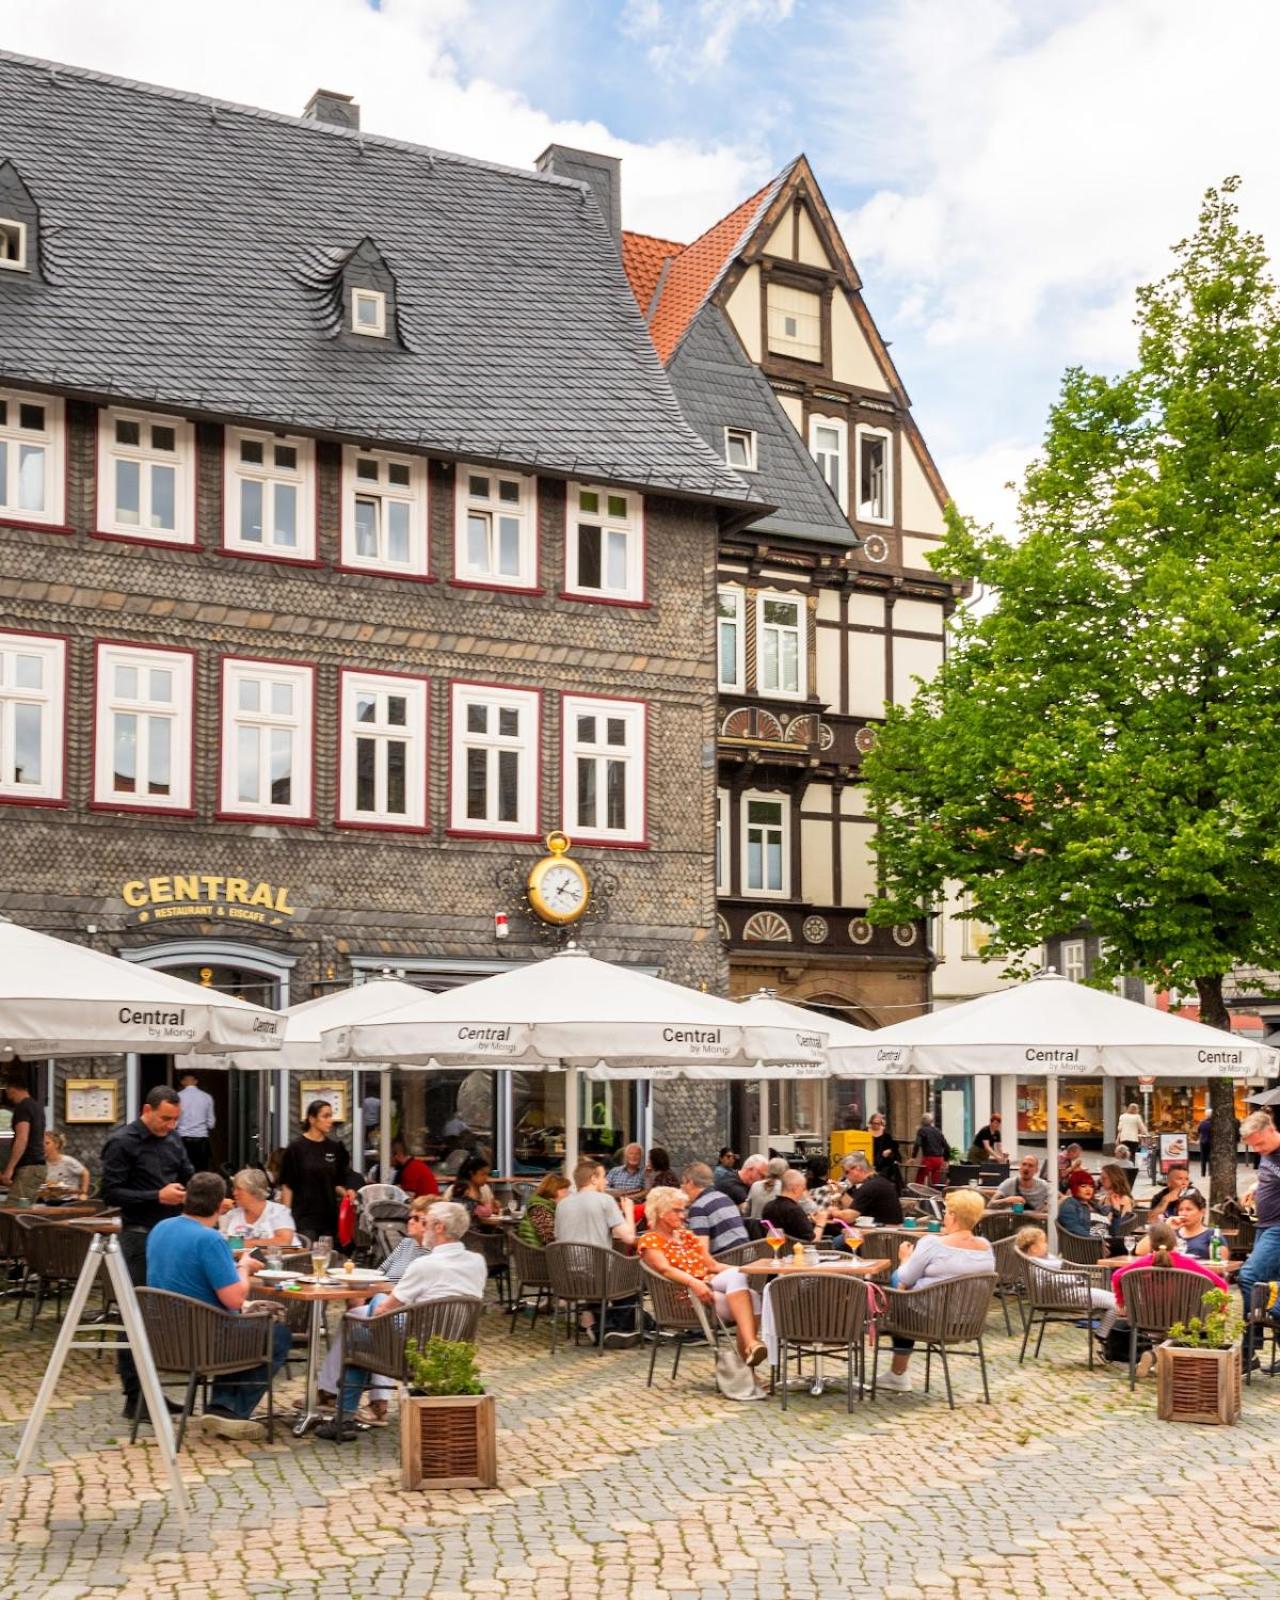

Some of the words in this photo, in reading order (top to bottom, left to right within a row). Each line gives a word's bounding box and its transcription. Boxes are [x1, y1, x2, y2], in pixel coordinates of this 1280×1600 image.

[122, 875, 295, 915] CENTRAL
[154, 906, 213, 919] RESTAURANT
[216, 907, 225, 916] &
[119, 1007, 185, 1026] Central
[253, 1017, 277, 1034] Central
[148, 1028, 160, 1038] by
[164, 1028, 195, 1040] Mongi
[457, 1026, 511, 1041] Central
[662, 1028, 721, 1043] Central
[1025, 1048, 1079, 1062] Central
[1197, 1050, 1242, 1064] Central
